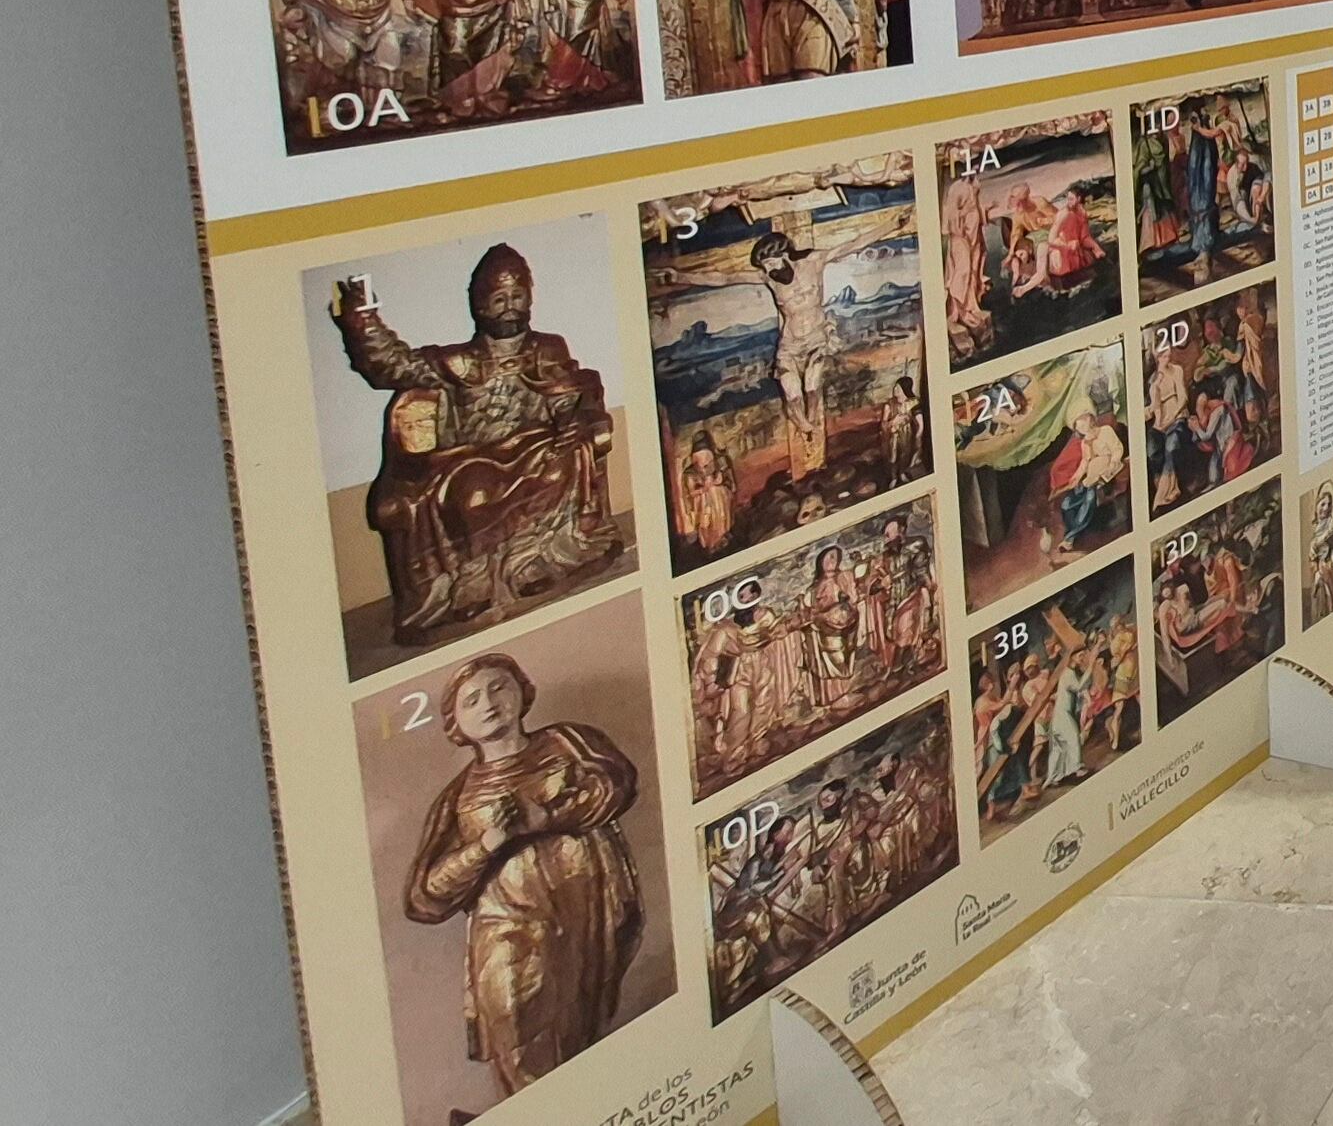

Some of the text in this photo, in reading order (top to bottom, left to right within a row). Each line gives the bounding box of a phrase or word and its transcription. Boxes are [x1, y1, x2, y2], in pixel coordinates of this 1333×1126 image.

[1144, 105, 1180, 133] 1D
[959, 145, 1001, 177] 1A
[675, 206, 700, 240] 3
[353, 273, 383, 313] 1
[1156, 323, 1190, 350] 2D
[976, 388, 1017, 421] 2A
[1164, 532, 1198, 562] 3D
[994, 622, 1030, 659] 3B
[402, 693, 434, 732] 2
[1120, 750, 1191, 807] Ayuntamiento
[1120, 764, 1189, 820] VALLECILLO
[638, 1089, 662, 1111] de
[666, 1067, 693, 1093] los
